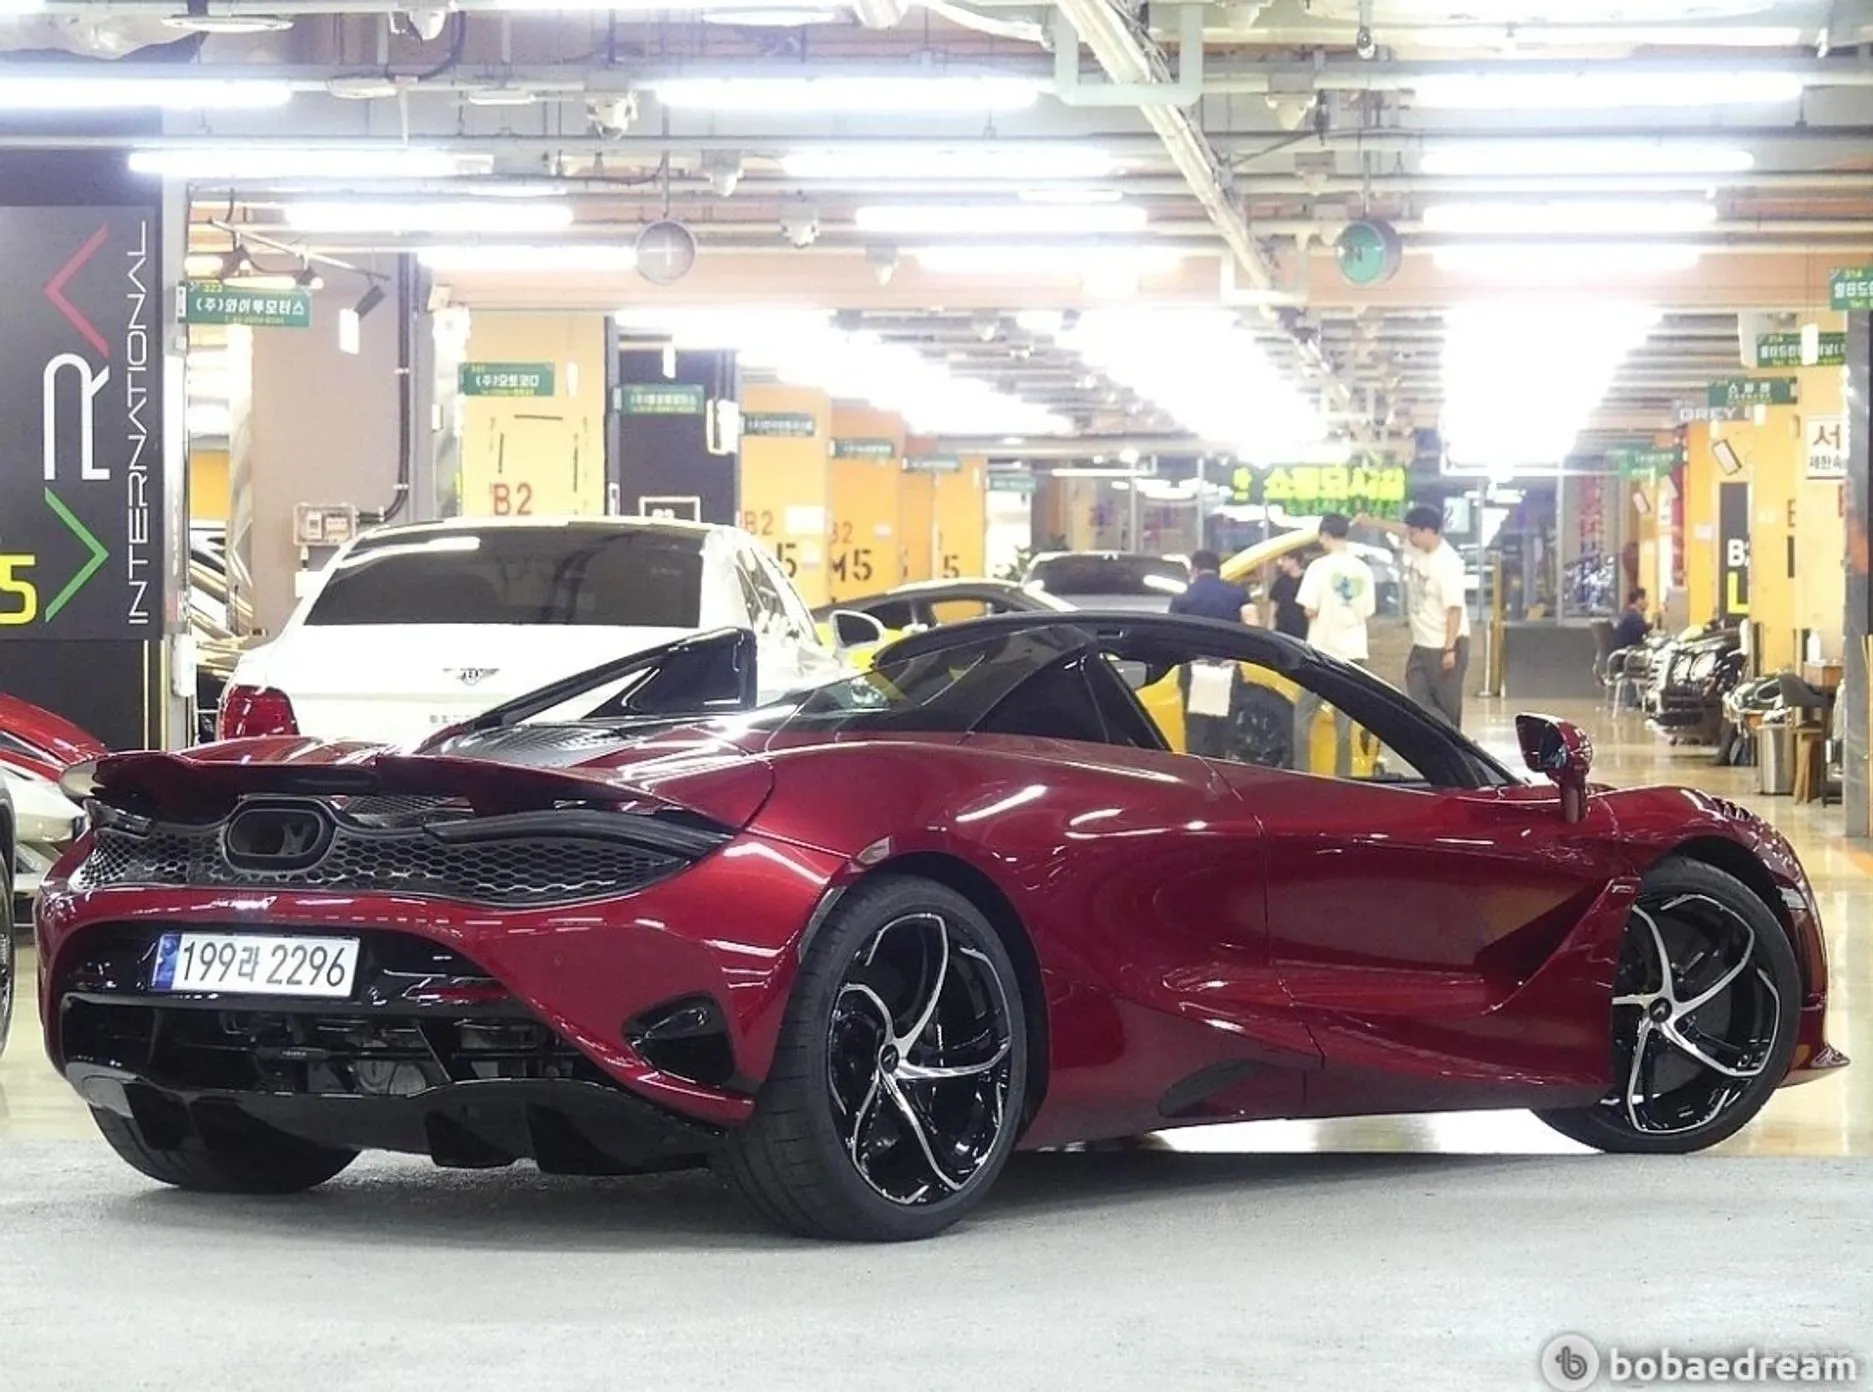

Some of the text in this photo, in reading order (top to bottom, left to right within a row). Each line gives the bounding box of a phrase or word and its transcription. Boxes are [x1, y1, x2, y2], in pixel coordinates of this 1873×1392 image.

[127, 220, 149, 625] INTERNATIONAL
[1809, 454, 1849, 470] 제한속
[492, 482, 533, 516] B2
[183, 941, 346, 987] 199라 2296
